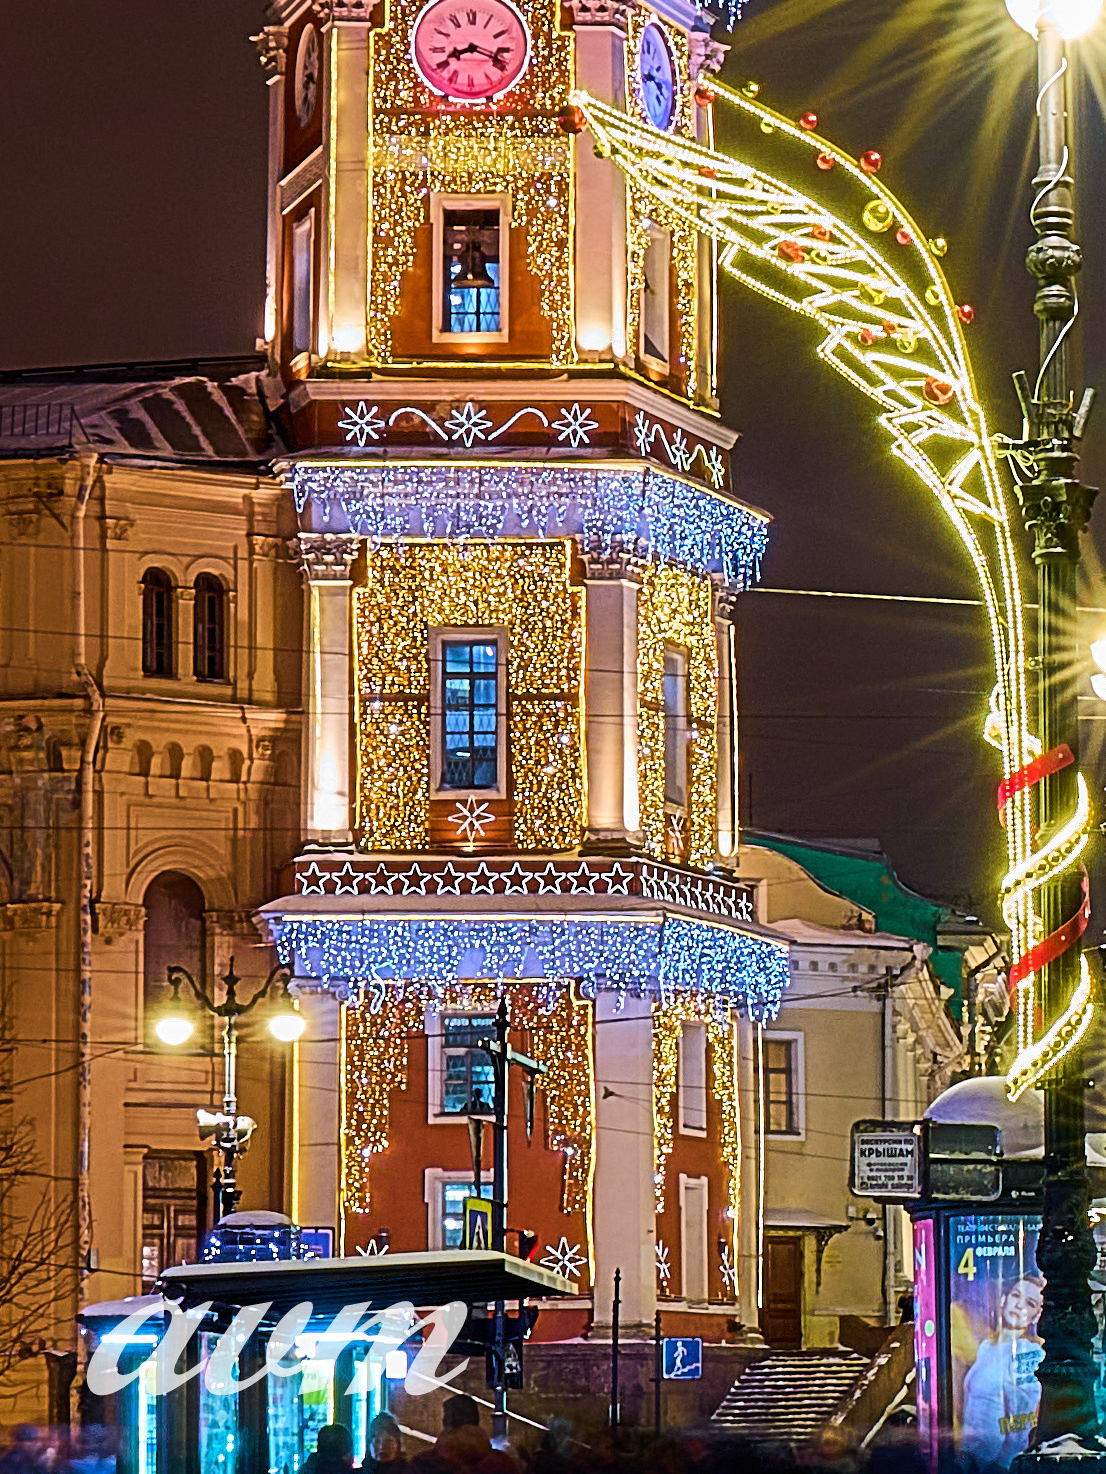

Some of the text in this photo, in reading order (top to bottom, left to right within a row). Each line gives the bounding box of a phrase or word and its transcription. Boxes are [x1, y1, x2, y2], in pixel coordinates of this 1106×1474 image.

[859, 1147, 914, 1158] КРЫШАМ
[956, 1233, 1016, 1244] ПРЕМЬЕРА
[975, 1245, 1016, 1257] ФЕВРАЛЯ
[957, 1247, 977, 1282] 4
